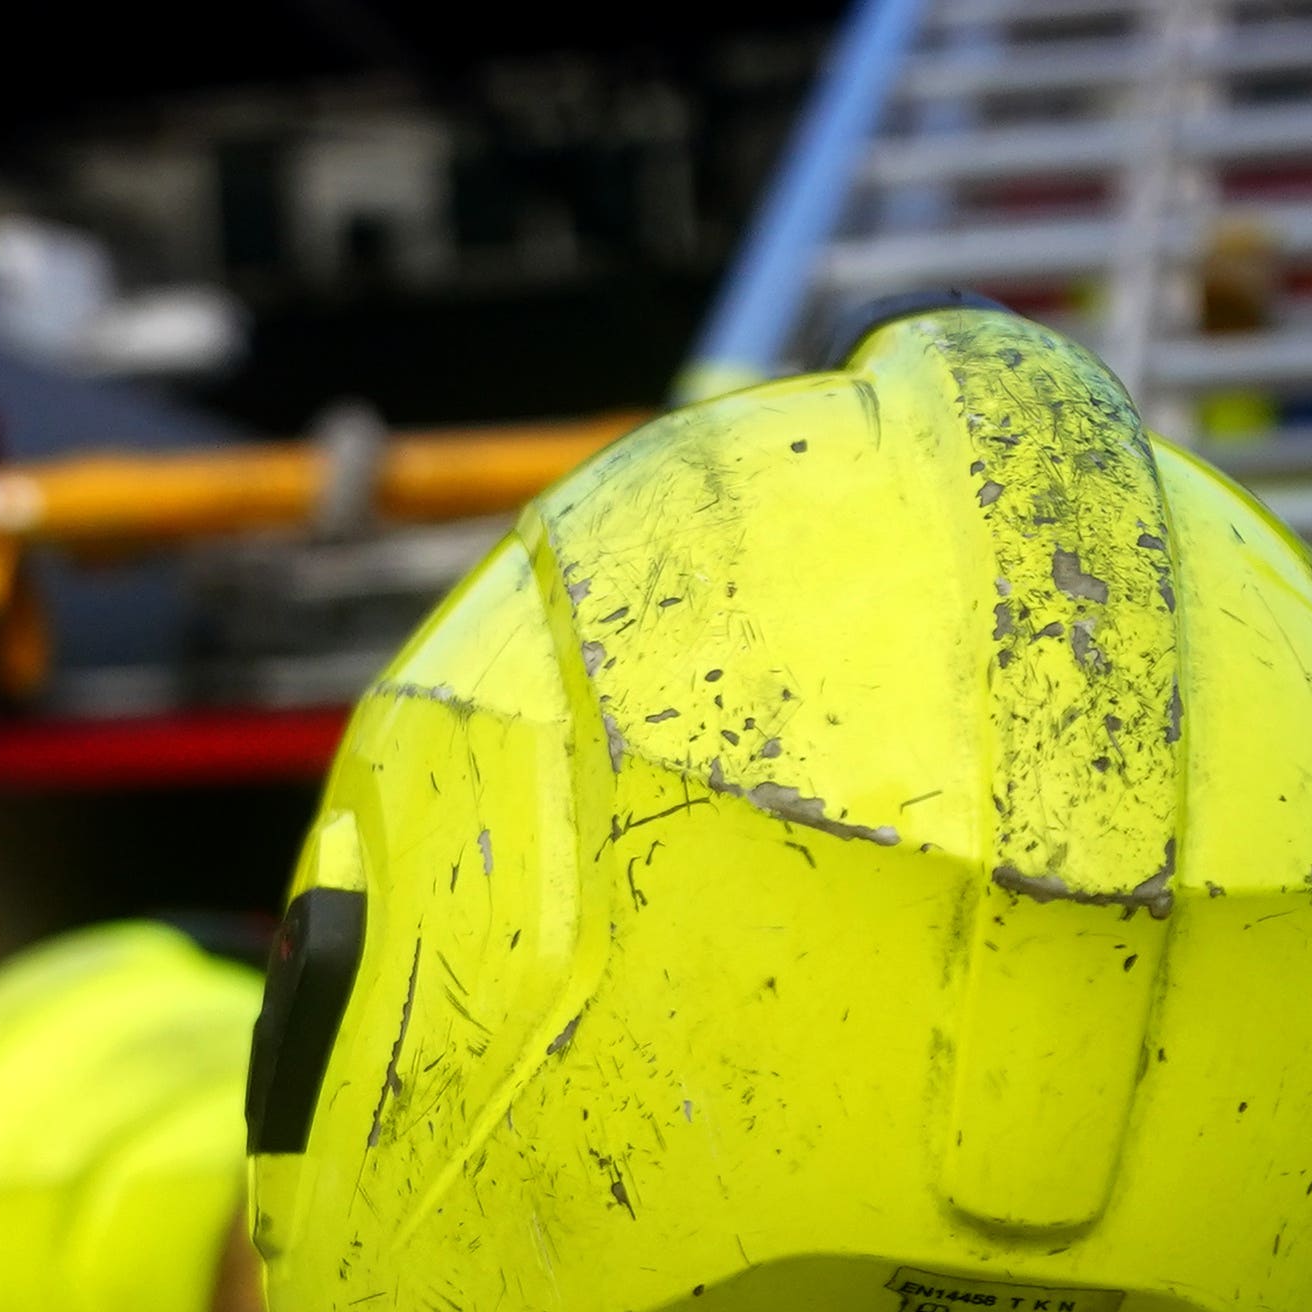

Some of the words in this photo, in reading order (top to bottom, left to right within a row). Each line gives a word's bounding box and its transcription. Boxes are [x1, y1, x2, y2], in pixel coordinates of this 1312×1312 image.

[1011, 1297, 1024, 1309] T
[1034, 1300, 1050, 1311] K
[1059, 1301, 1075, 1312] N
